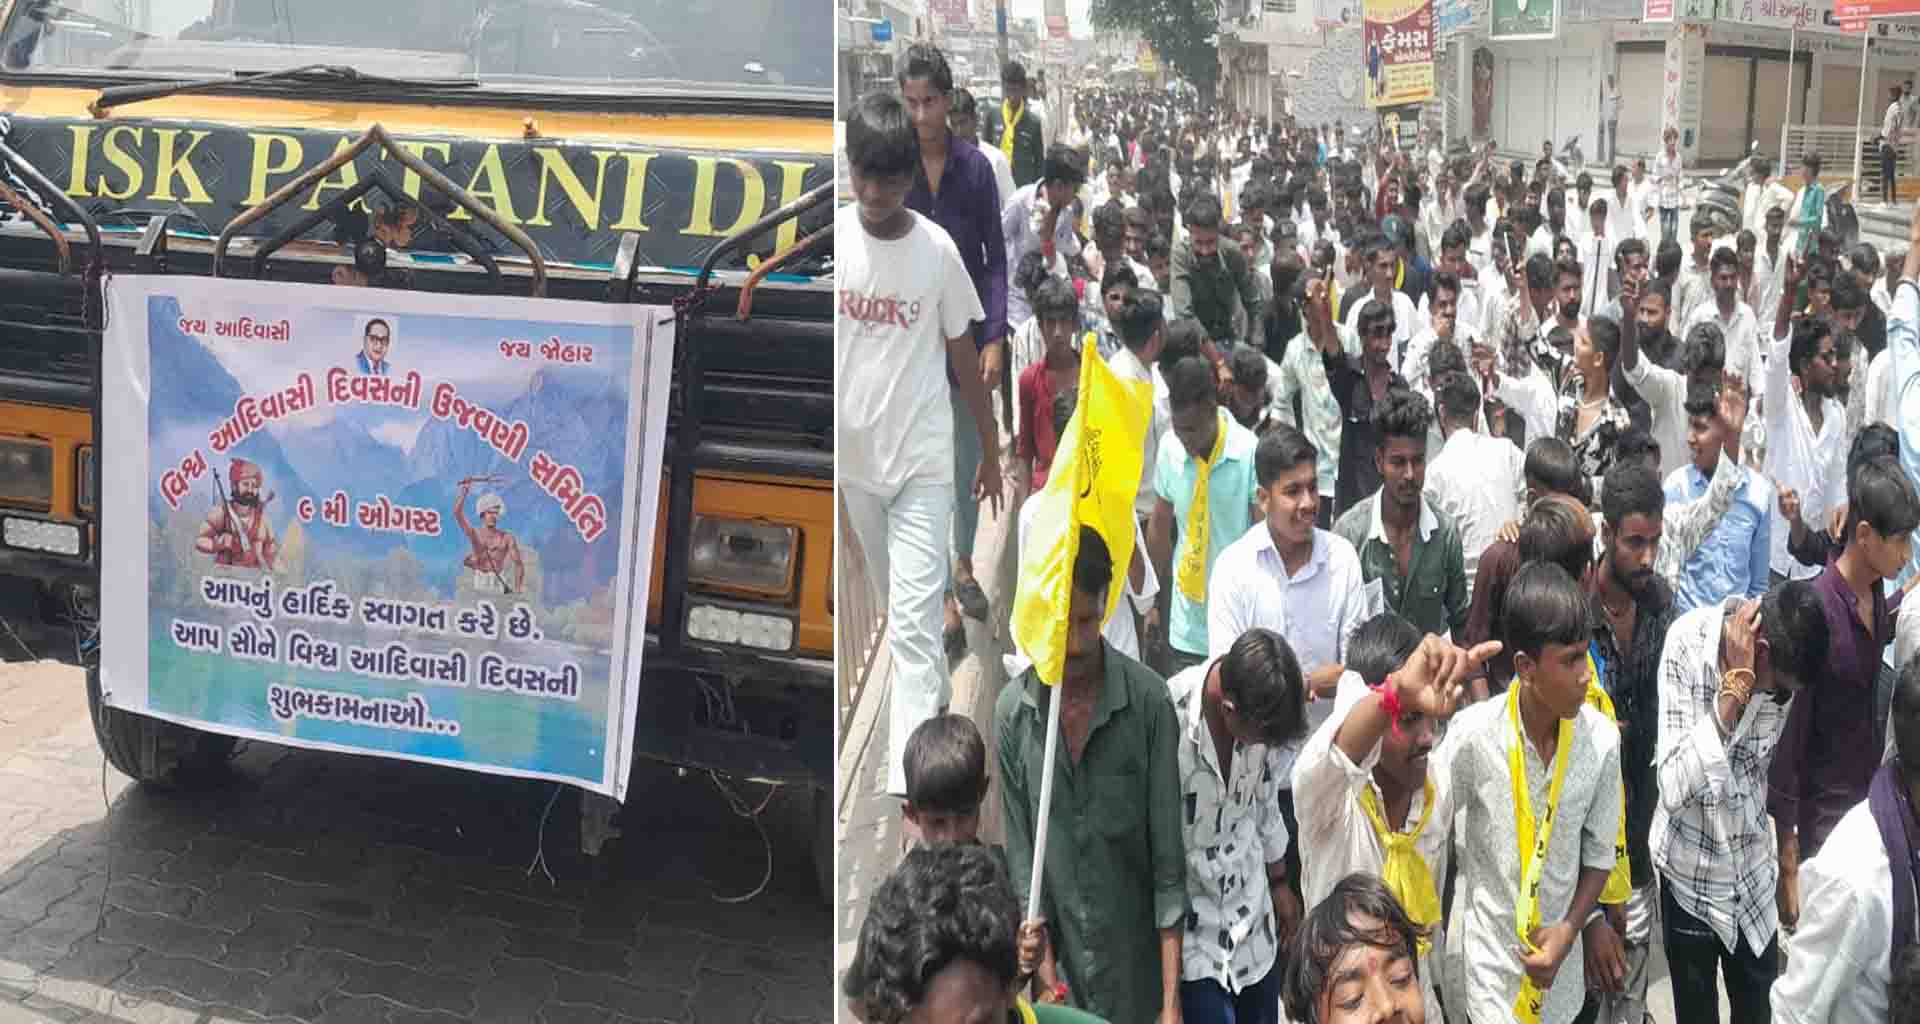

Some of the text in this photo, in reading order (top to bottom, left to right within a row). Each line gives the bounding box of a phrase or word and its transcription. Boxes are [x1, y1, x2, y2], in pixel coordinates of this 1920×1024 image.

[65, 125, 214, 204] ISK
[680, 155, 815, 270] DJ
[180, 316, 290, 341] જય આદિવાસી
[500, 336, 593, 362] જય જોહાર
[161, 367, 606, 540] વિશ્વ આદિવાસી દિવસની ઉજવણી સમિતિ
[324, 492, 347, 524] મી
[358, 496, 440, 534] ઓગસ્ટ
[204, 580, 540, 640] આપનું હાર્દિક સ્વાગત કરે છે.
[175, 623, 577, 696] આપ સૌને વિશ્વ આદિવાસી દિવસની
[271, 687, 456, 731] શુભકામનાઓ...
